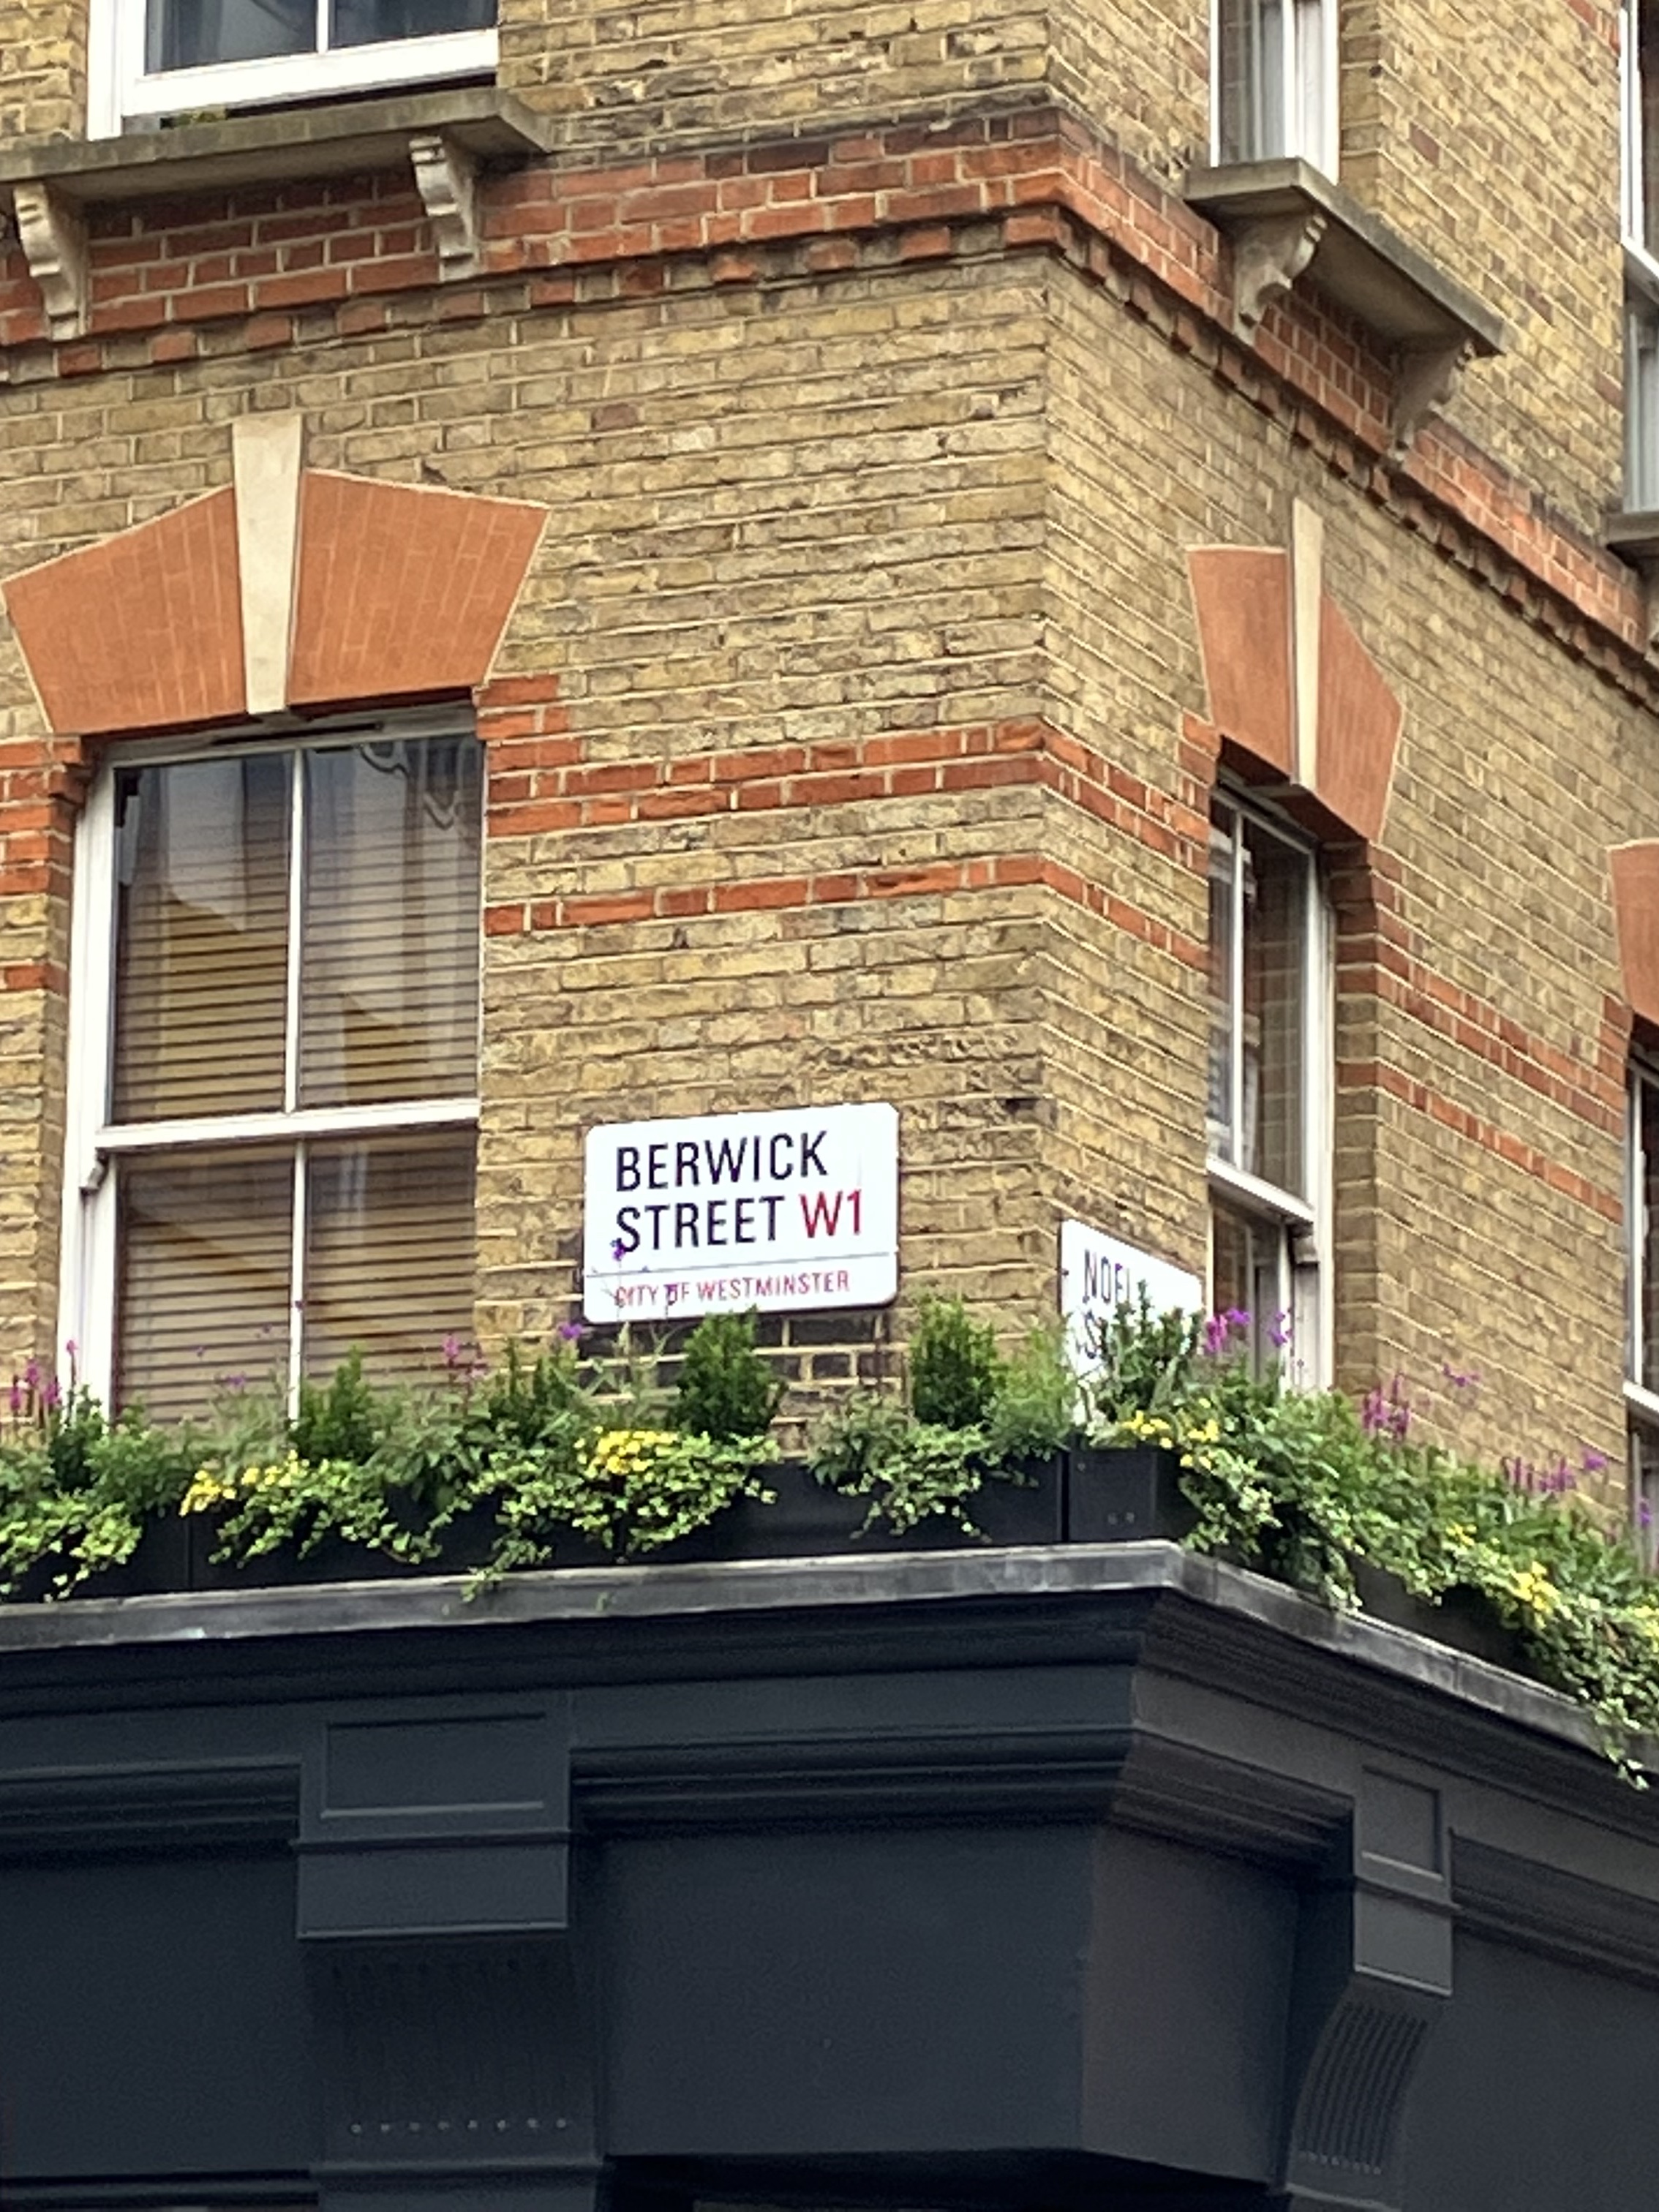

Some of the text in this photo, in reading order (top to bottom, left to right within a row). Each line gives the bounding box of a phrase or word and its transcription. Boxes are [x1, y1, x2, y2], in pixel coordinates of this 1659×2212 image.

[616, 1130, 827, 1192] BERWICK
[615, 1189, 862, 1253] STREET W1
[615, 1271, 850, 1308] CITY OF WESTMINSTER
